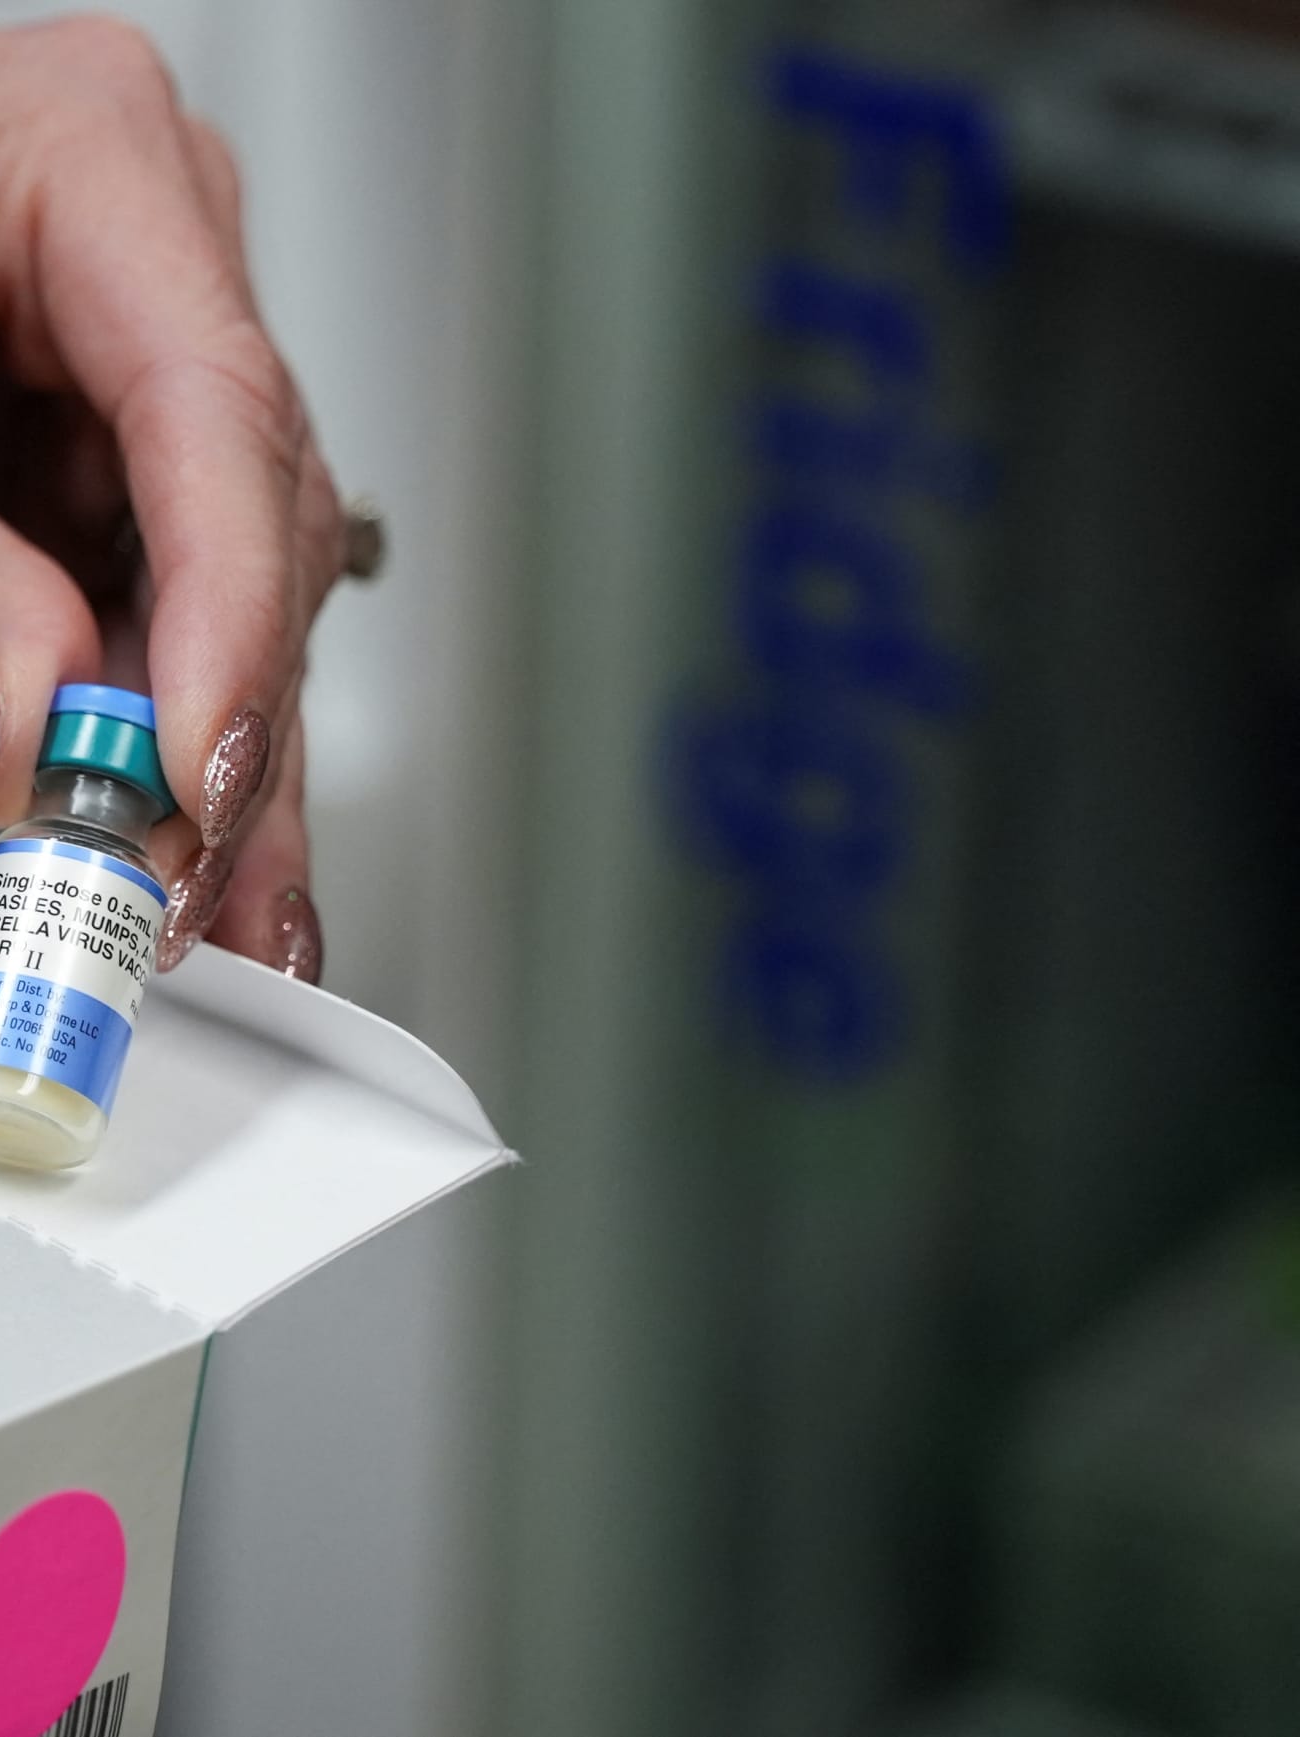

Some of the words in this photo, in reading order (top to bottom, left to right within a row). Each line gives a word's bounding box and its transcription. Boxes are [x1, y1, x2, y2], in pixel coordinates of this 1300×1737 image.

[73, 906, 140, 957] MUMPS,
[107, 896, 152, 939] 0.5-mL
[59, 924, 114, 960] VIRUS
[24, 950, 44, 970] II
[16, 980, 43, 997] Dist.
[21, 1000, 32, 1013] &
[79, 1019, 100, 1040] LLC
[15, 1037, 36, 1054] No.
[52, 1029, 77, 1051] USA
